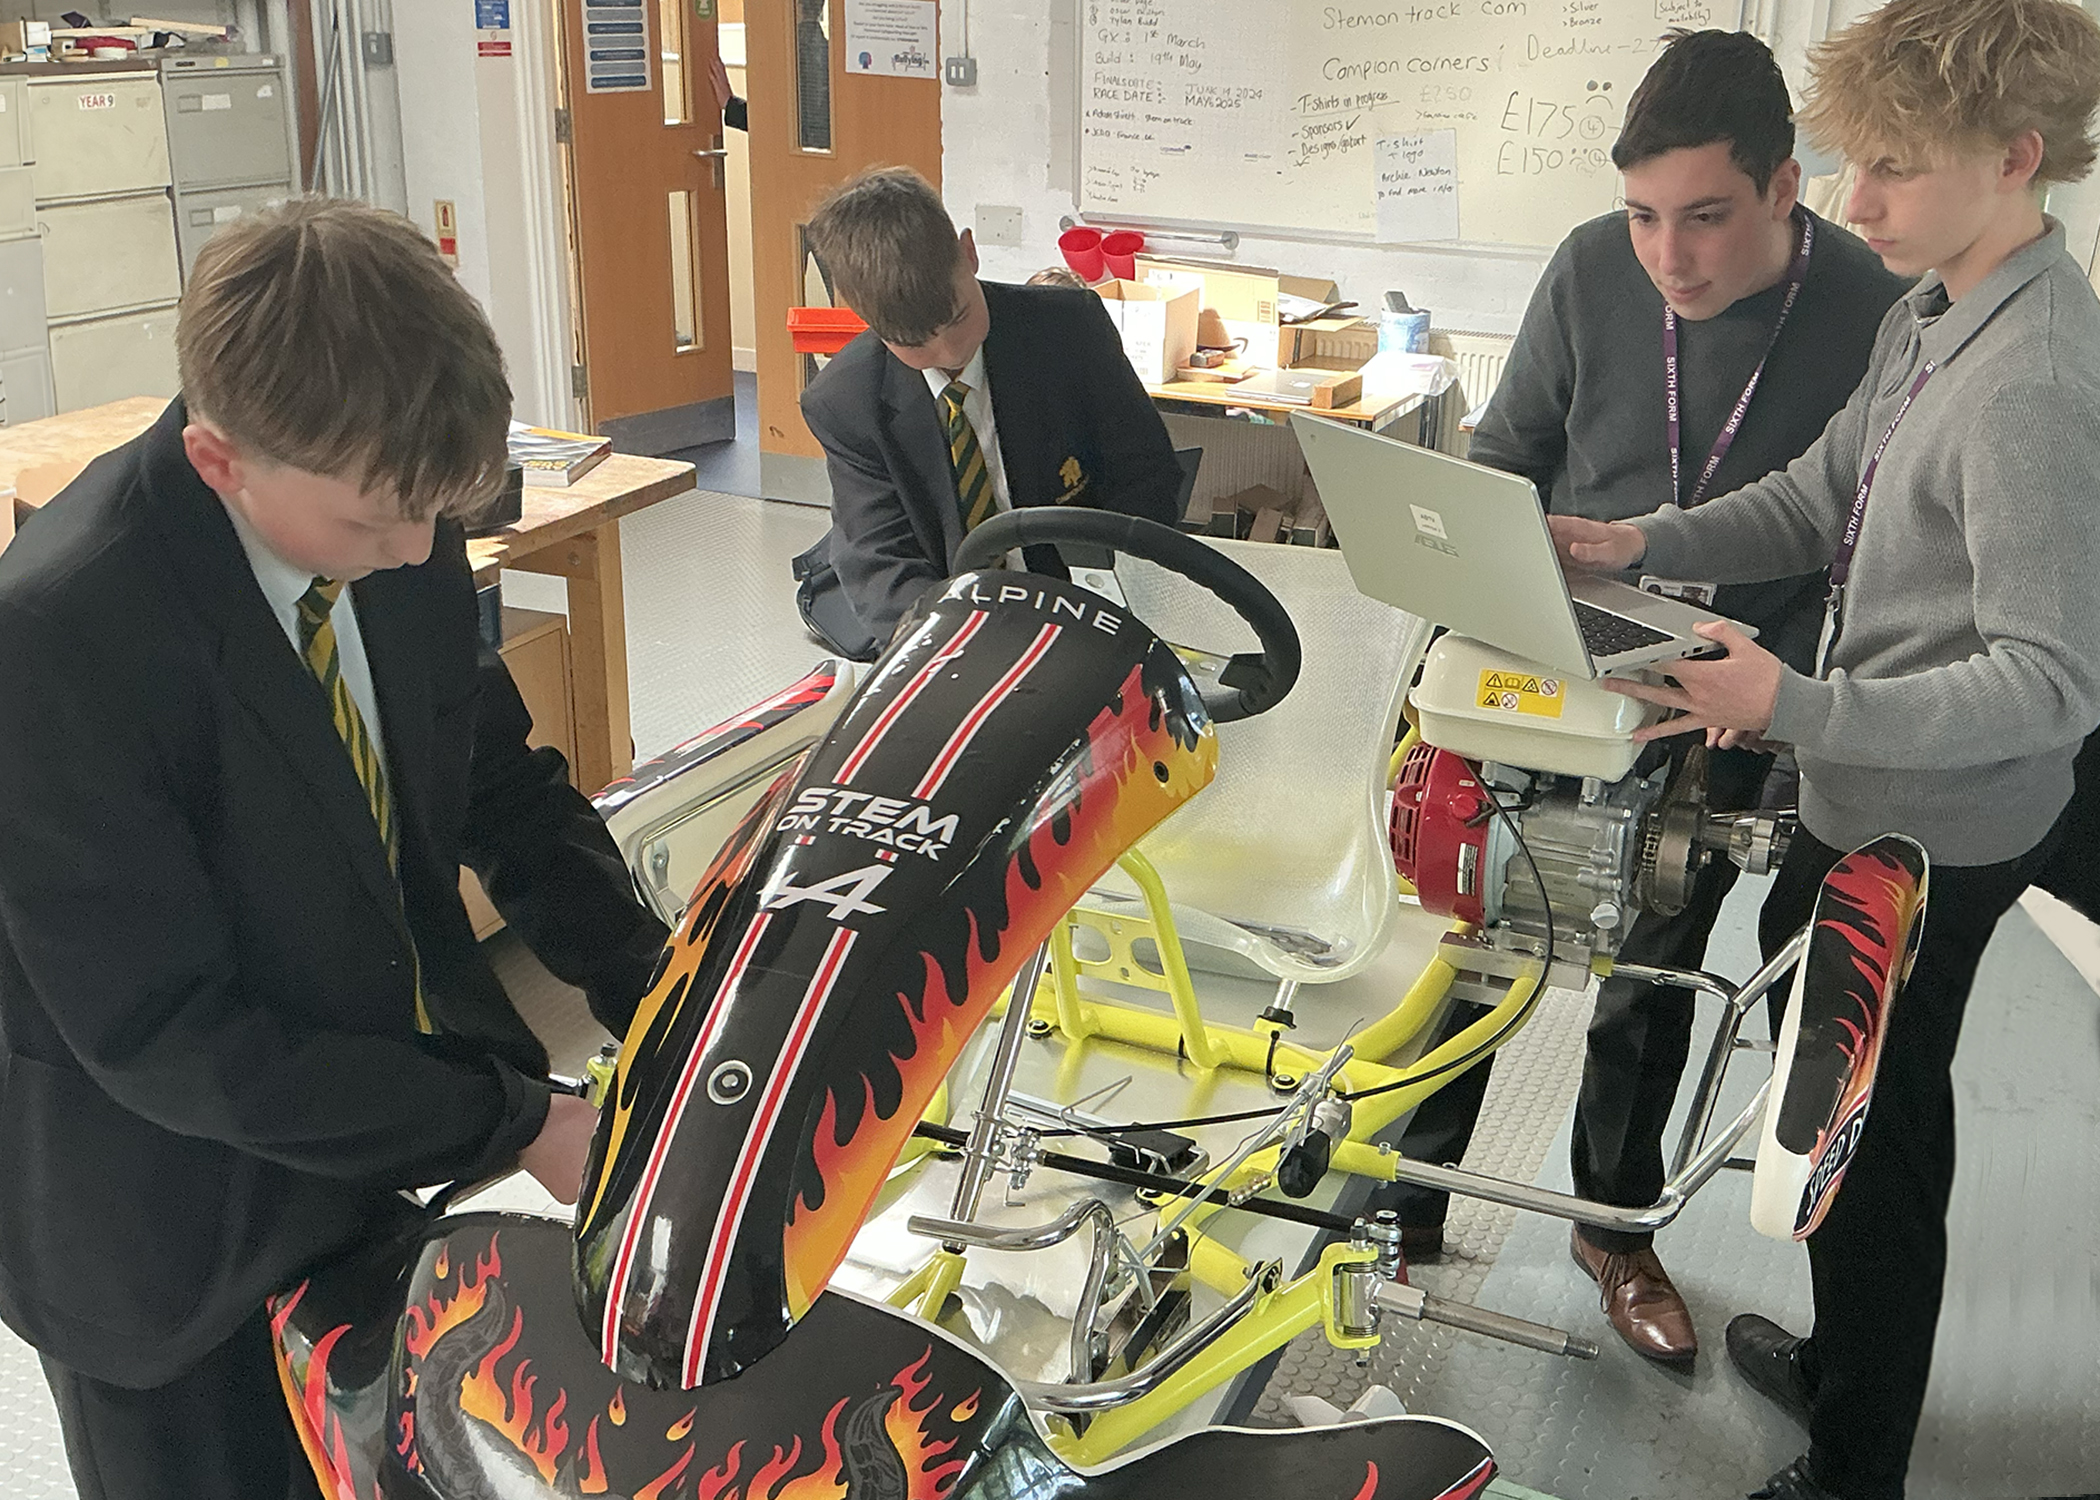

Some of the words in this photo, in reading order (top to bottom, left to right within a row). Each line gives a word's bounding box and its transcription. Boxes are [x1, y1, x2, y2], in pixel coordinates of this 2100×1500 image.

[1405, 2, 1461, 23] track
[1167, 33, 1205, 49] March
[1527, 34, 1610, 60] Deadline
[1095, 52, 1122, 64] Build
[1150, 52, 1173, 63] 19th
[1180, 55, 1202, 75] May
[1407, 56, 1489, 73] corners
[80, 96, 106, 108] YEAR
[107, 95, 114, 107] 9
[1093, 88, 1119, 100] RACE
[1124, 91, 1153, 102] DATE
[1500, 91, 1577, 139] £175
[1498, 141, 1563, 175] £150
[1665, 305, 1674, 331] ORM
[1667, 357, 1676, 388] SIXTH
[1668, 391, 1677, 422] FORM
[1725, 403, 1746, 434] SIXTH
[1741, 372, 1759, 403] FORM
[1874, 429, 1892, 462] SIXTH
[1891, 396, 1911, 429] FORM
[1671, 447, 1679, 479] SIXTH
[1700, 455, 1720, 484] FORM
[1843, 516, 1859, 546] SIXTH
[1852, 484, 1868, 516] FORM
[937, 582, 1123, 637] ALPINE
[786, 787, 960, 844] STEM
[776, 815, 822, 832] ON
[828, 817, 948, 861] TRACK
